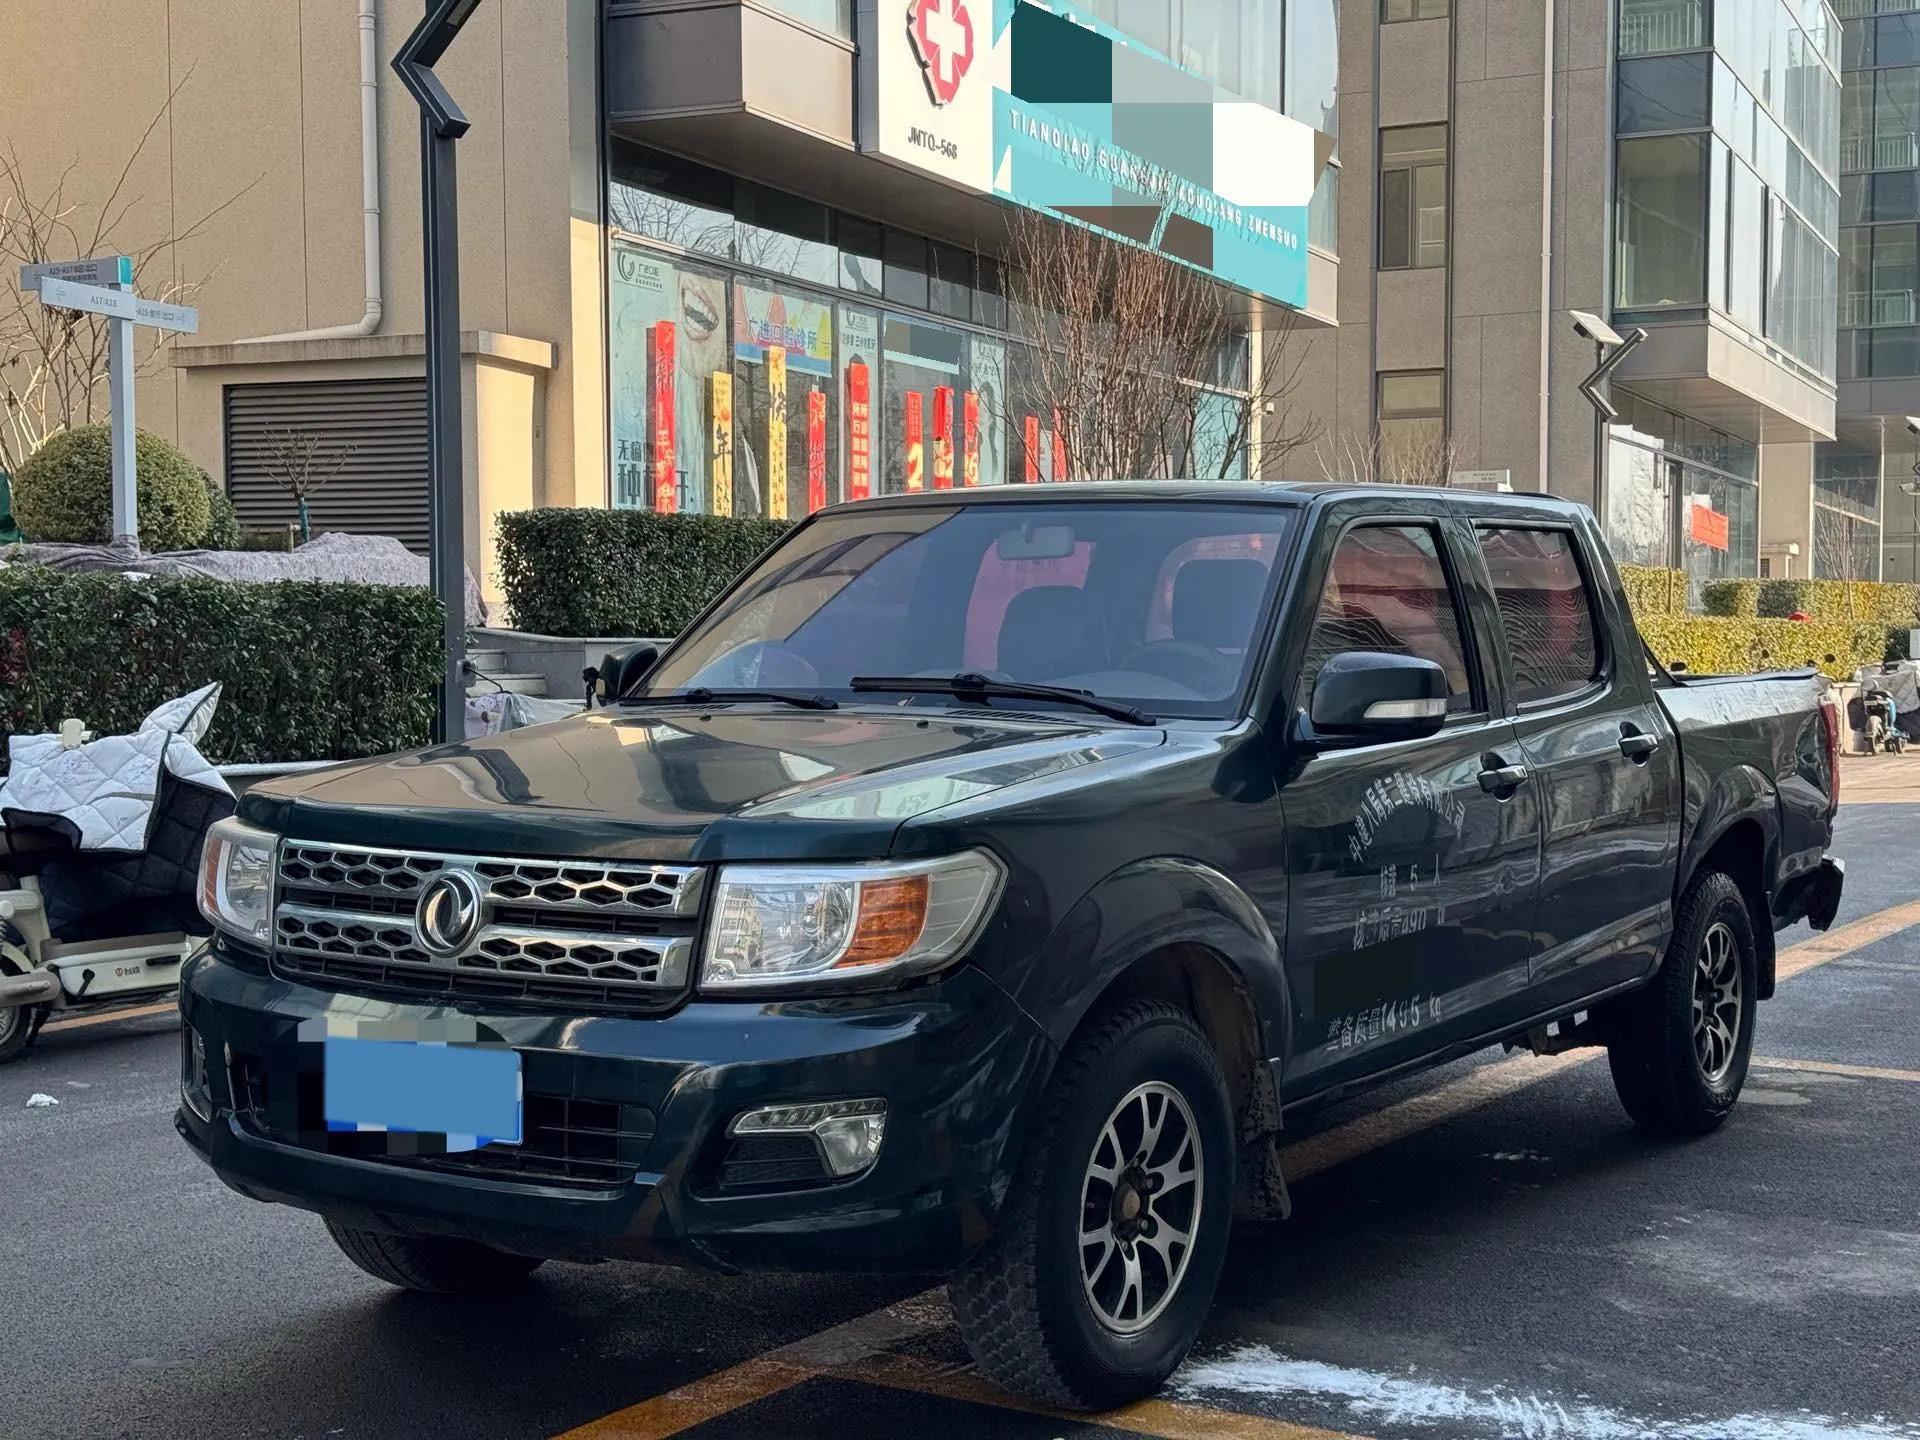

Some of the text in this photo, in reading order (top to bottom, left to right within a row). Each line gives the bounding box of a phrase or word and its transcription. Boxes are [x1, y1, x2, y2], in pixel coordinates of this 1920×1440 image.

[907, 126, 958, 160] JNTQ-568
[1009, 108, 1089, 162] TIANQIAO
[1247, 213, 1298, 251] ZHENSUO
[1429, 991, 1442, 1024] kg
